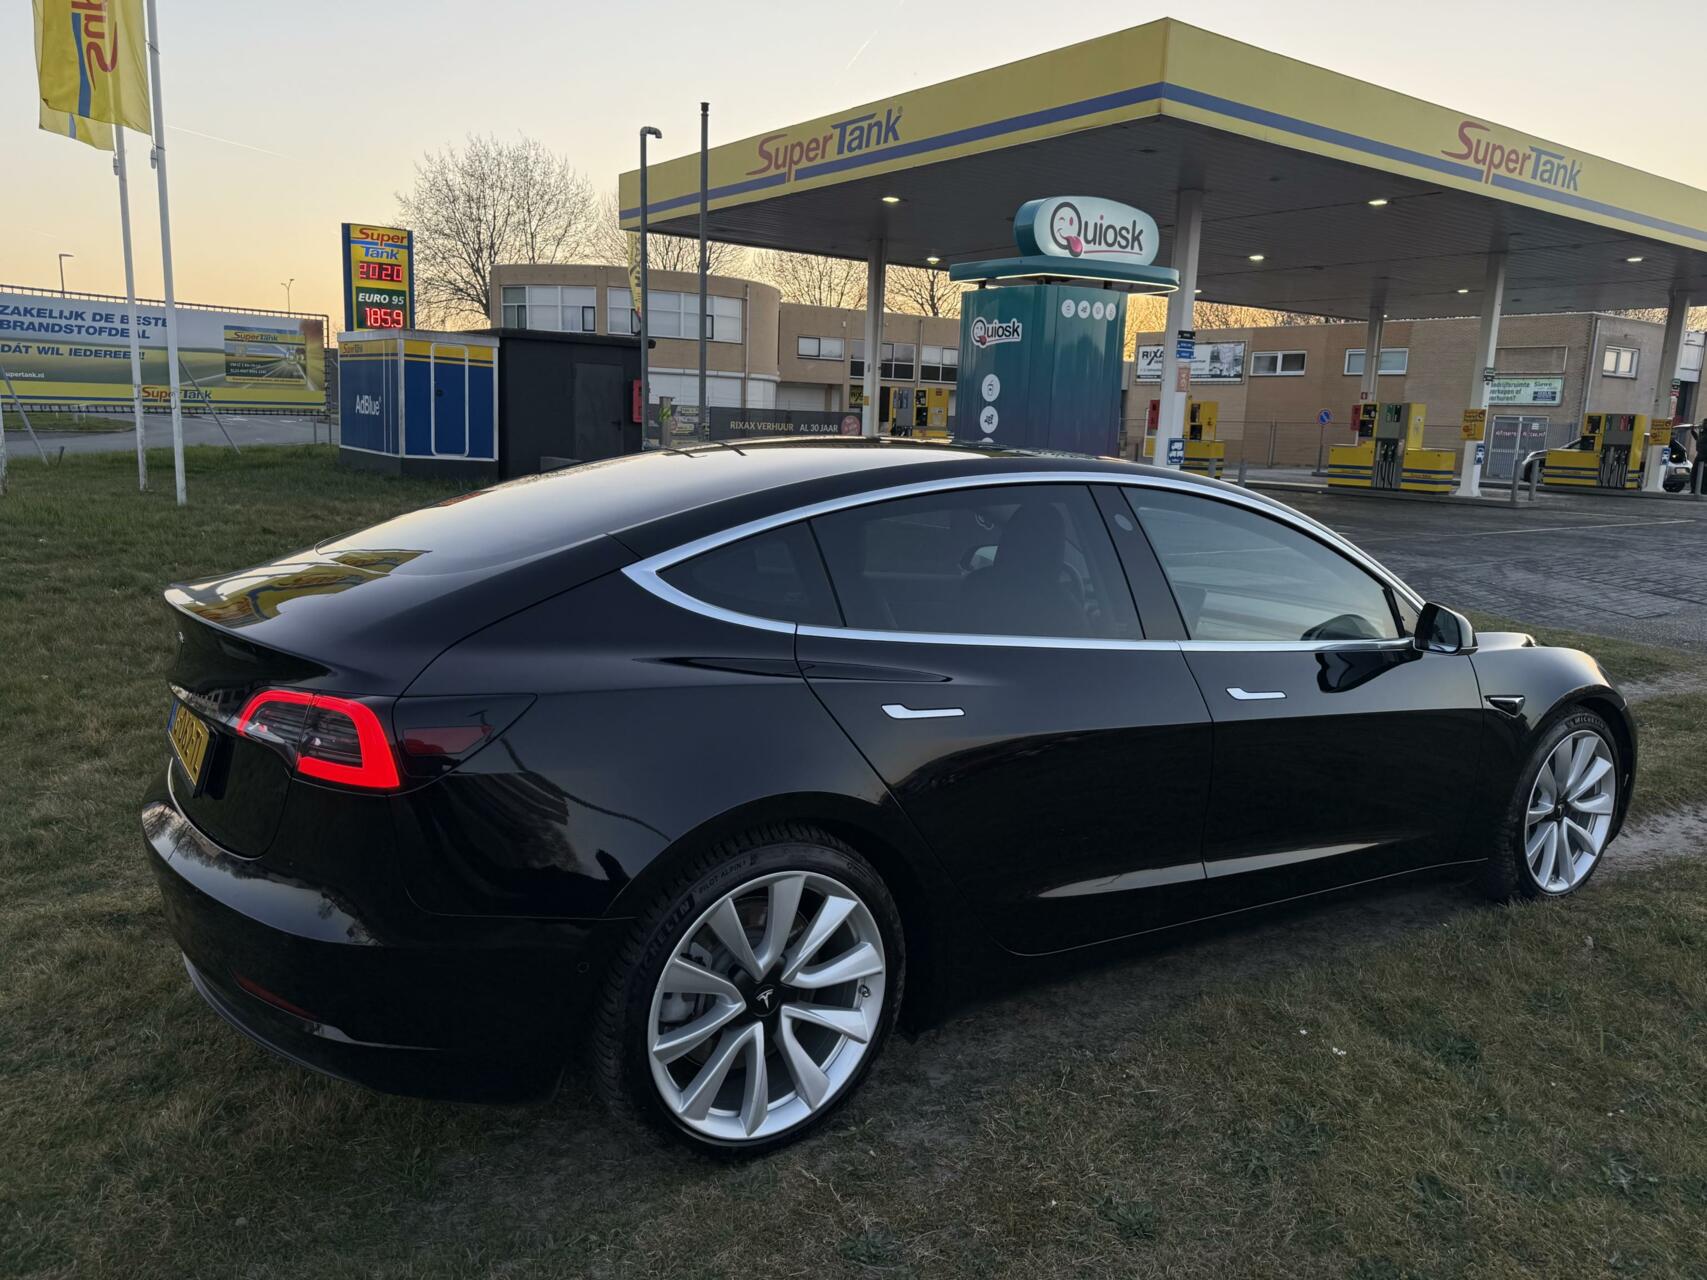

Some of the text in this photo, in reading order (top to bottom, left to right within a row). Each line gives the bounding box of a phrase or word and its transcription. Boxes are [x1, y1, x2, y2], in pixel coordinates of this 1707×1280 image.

[745, 108, 900, 183] SuperTank
[1441, 120, 1581, 192] SuperTank
[352, 227, 407, 247] Super
[1050, 201, 1143, 257] Quiosk
[360, 246, 399, 260] Tank
[358, 292, 404, 305] EURO 95
[0, 305, 86, 322] ZAKELIJK
[92, 312, 115, 323] DE
[972, 318, 1020, 345] Quiosk
[1, 342, 32, 354] DÁT
[37, 347, 63, 356] WIL
[5, 371, 45, 379] upertank.nl
[142, 386, 212, 402] SupTank
[355, 395, 380, 416] AdBlue
[730, 421, 838, 433] RIXAX VERHUUR AL 30 JAAR
